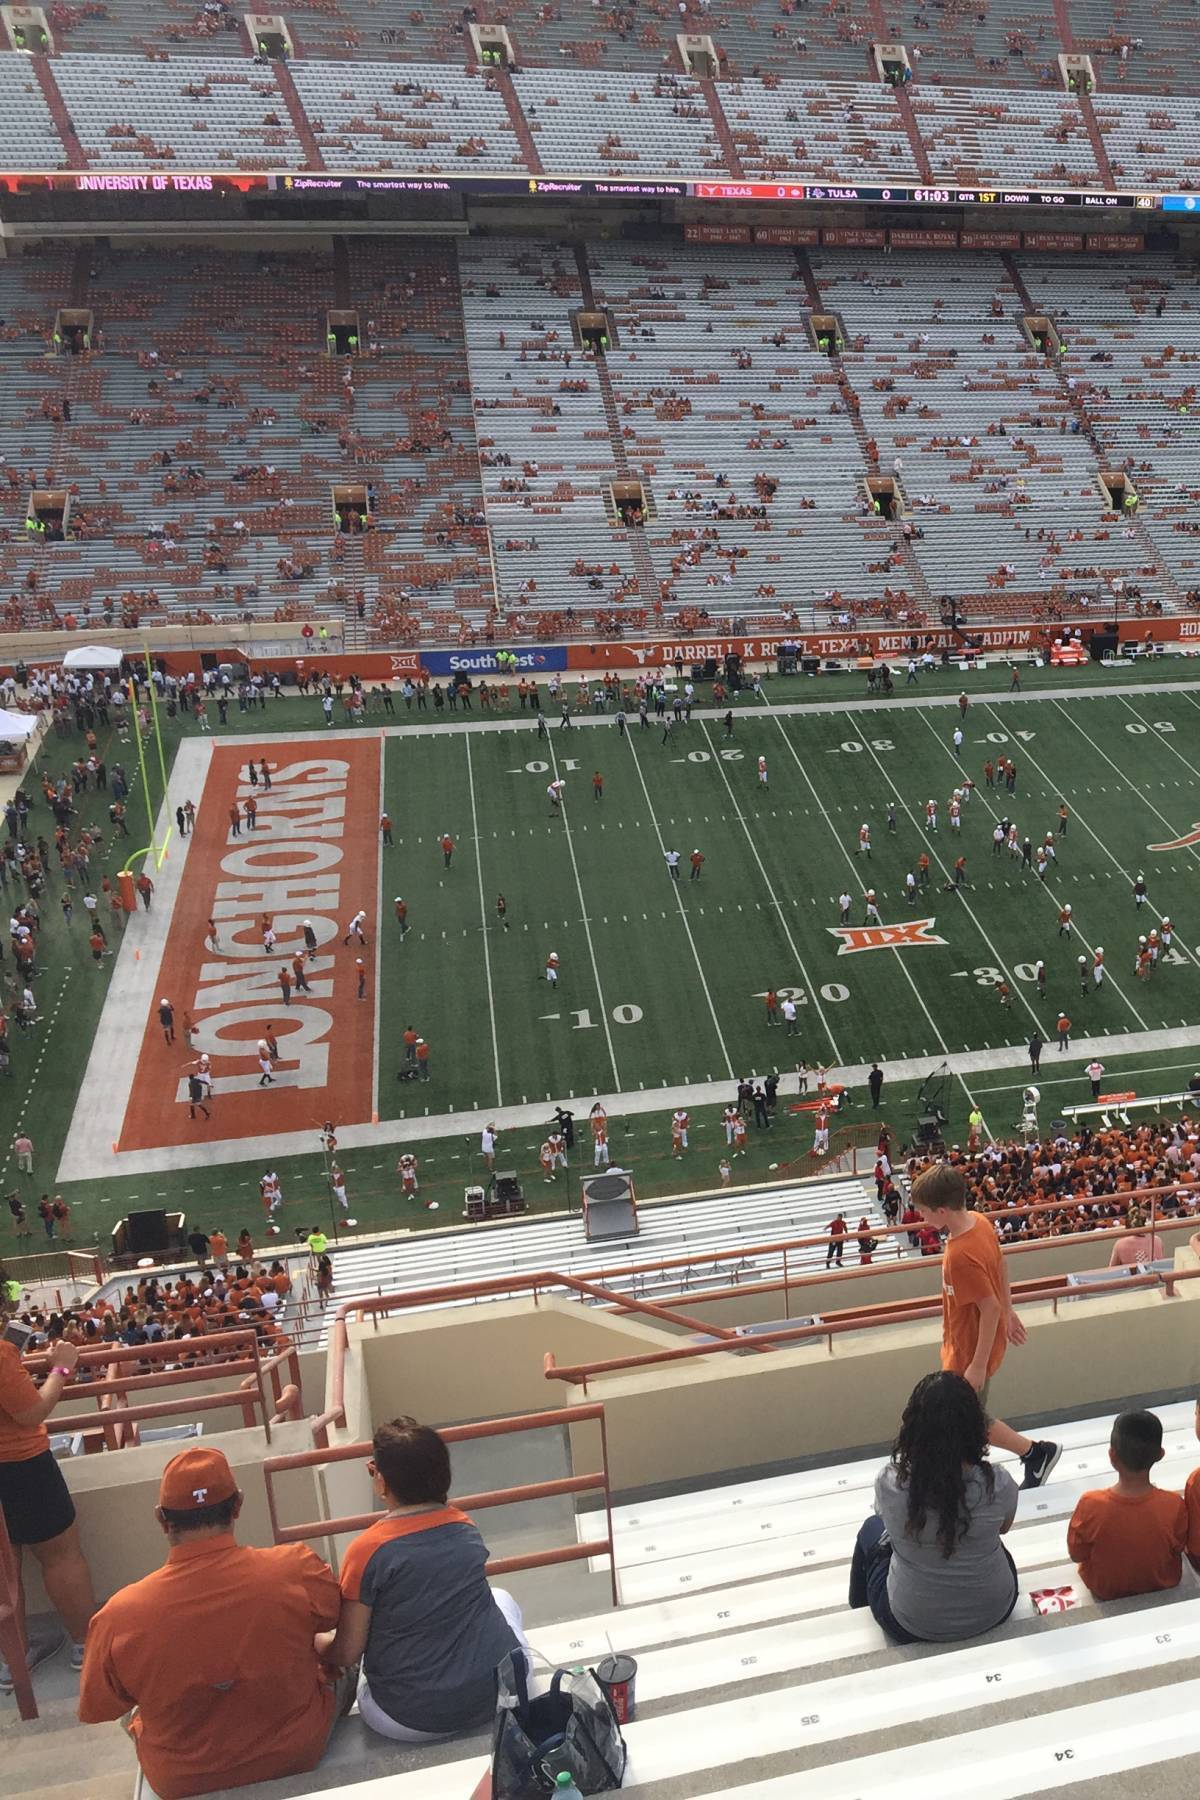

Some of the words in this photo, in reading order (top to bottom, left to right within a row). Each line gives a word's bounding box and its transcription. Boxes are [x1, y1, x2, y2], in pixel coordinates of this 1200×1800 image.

[76, 175, 148, 190] UNIVERSITY
[153, 176, 168, 190] OF
[172, 176, 213, 190] TEXAS
[294, 179, 342, 189] ZipRecruiter
[356, 180, 371, 188] The
[537, 182, 582, 192] ZipRecruiter
[641, 186, 655, 194] way
[720, 187, 752, 196] TEXAS
[777, 187, 785, 196] 0
[827, 189, 858, 198] TULSA
[882, 190, 890, 199] 0
[914, 190, 950, 202] 61:03
[958, 193, 975, 201] QTR
[978, 192, 996, 202] 1ST
[1004, 194, 1029, 202] DOWN
[1041, 195, 1051, 203] TO
[1052, 196, 1065, 204] GO
[1085, 197, 1104, 205] BALL
[1105, 197, 1118, 205] ON
[1138, 198, 1151, 207] 40
[756, 231, 768, 240] 60
[825, 232, 836, 241] 10
[1026, 237, 1036, 246] 34
[663, 645, 733, 661] DARRELL
[743, 643, 755, 657] K
[450, 653, 535, 670] Southest
[175, 759, 350, 1102] LONGHORNS
[972, 963, 1041, 986] 30
[570, 1004, 644, 1029] 10
[193, 1488, 207, 1504] T
[1154, 1633, 1173, 1645] 33
[984, 1672, 1003, 1684] 34
[799, 1713, 821, 1727] 35
[1053, 1748, 1076, 1762] 34
